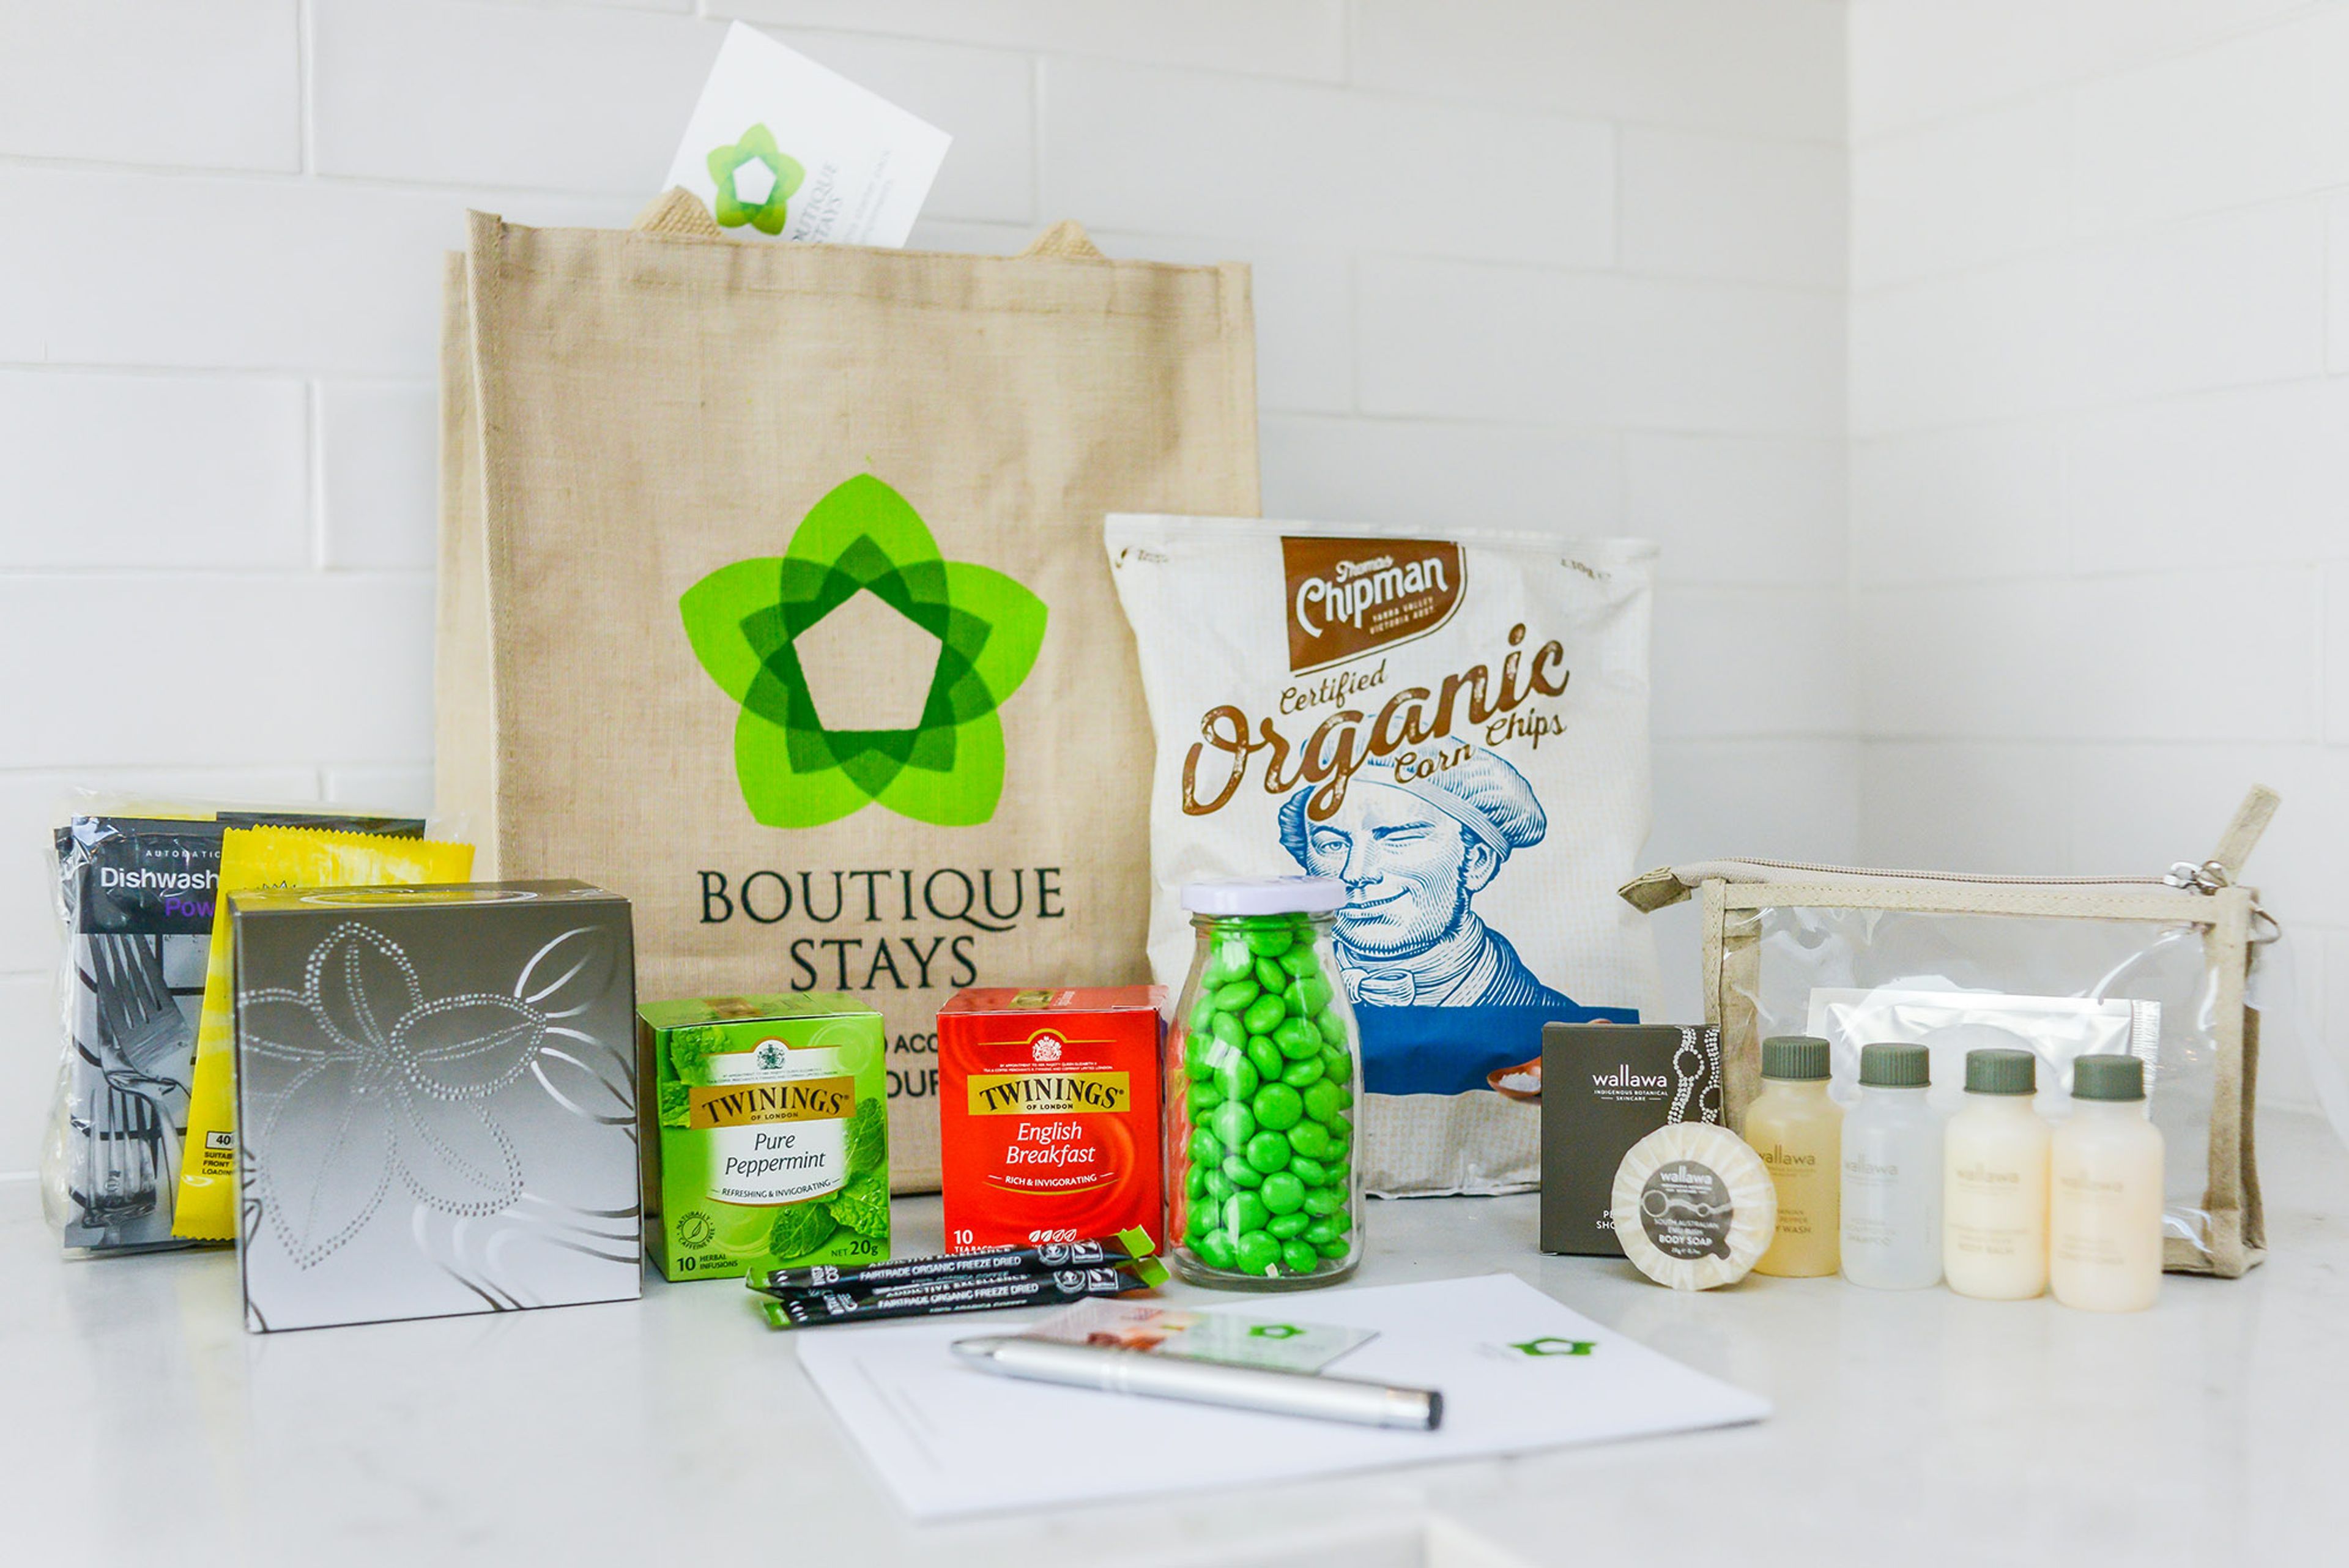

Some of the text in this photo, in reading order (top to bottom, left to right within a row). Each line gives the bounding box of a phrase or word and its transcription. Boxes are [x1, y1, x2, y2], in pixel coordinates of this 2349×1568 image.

[1335, 555, 1393, 583] Thomas
[1296, 557, 1449, 638] Chipman
[1373, 596, 1433, 622] YARRA VALLEY
[1370, 617, 1409, 634] VICTORIA
[1280, 658, 1387, 715] Certified
[1182, 623, 1570, 822] Organic
[1395, 708, 1567, 784] Corn Chips
[146, 850, 221, 859] AUTOMATIC
[698, 868, 1066, 932] BOUTIQUE
[790, 935, 978, 992] STAYS
[1592, 1065, 1668, 1088] wallawa
[765, 1112, 798, 1120] LONDON
[216, 1135, 232, 1145] 40
[754, 1133, 795, 1151] Pure
[1017, 1121, 1082, 1145] English
[725, 1151, 826, 1177] Peppermint
[1006, 1145, 1096, 1167] Breakfast
[1005, 1176, 1026, 1186] RICH
[1034, 1173, 1097, 1187] INVIGORATING
[1660, 1165, 1713, 1185] wallawa
[722, 1187, 768, 1197] REFRESHING
[775, 1179, 831, 1197] INVIGORATING
[850, 1239, 878, 1256] 20g
[954, 1229, 973, 1244] 10
[1659, 1234, 1713, 1246] BODY SOAP
[677, 1257, 696, 1271] 10
[700, 1260, 738, 1269] INFUSIONS
[859, 1255, 1021, 1280] FAIRTRADE ORGANIC FREEZE DRIED
[877, 1283, 1039, 1309] FAIRTRADE ORGANIC FREEZE DRIED
